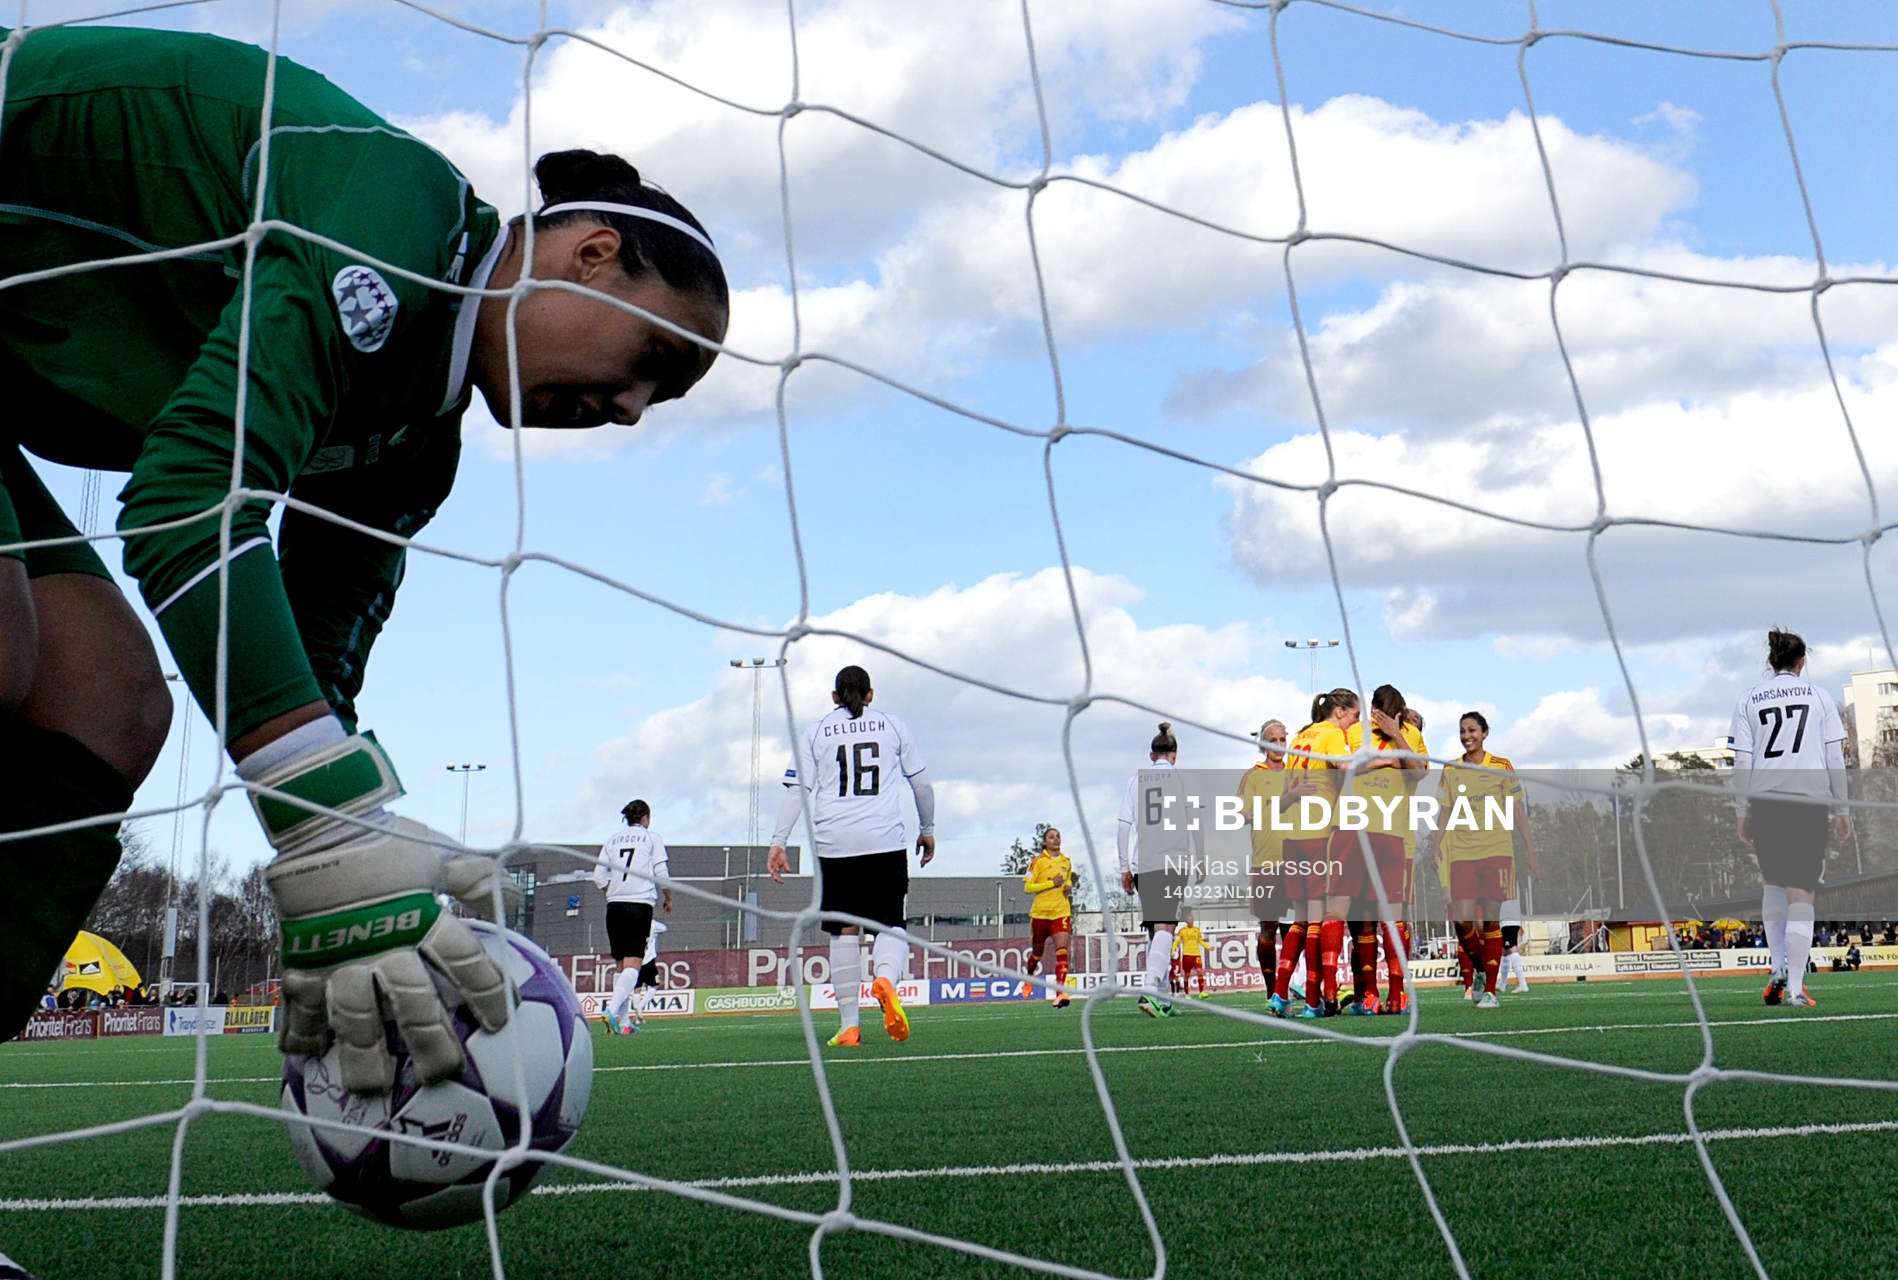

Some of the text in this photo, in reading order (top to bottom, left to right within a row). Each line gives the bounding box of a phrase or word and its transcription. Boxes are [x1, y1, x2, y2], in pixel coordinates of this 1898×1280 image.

[824, 720, 886, 738] CELOUCH
[1758, 704, 1811, 759] 27
[835, 741, 880, 798] 16
[1145, 787, 1163, 826] 6
[620, 847, 636, 882] 7
[288, 908, 421, 954] BENETT
[923, 941, 1043, 980] Finans
[1233, 970, 1266, 986] Fina
[1574, 962, 1594, 971] ALLA
[25, 1014, 93, 1038] Prioritet Finans
[104, 1012, 137, 1033] Prioritet
[137, 1010, 161, 1031] Finans
